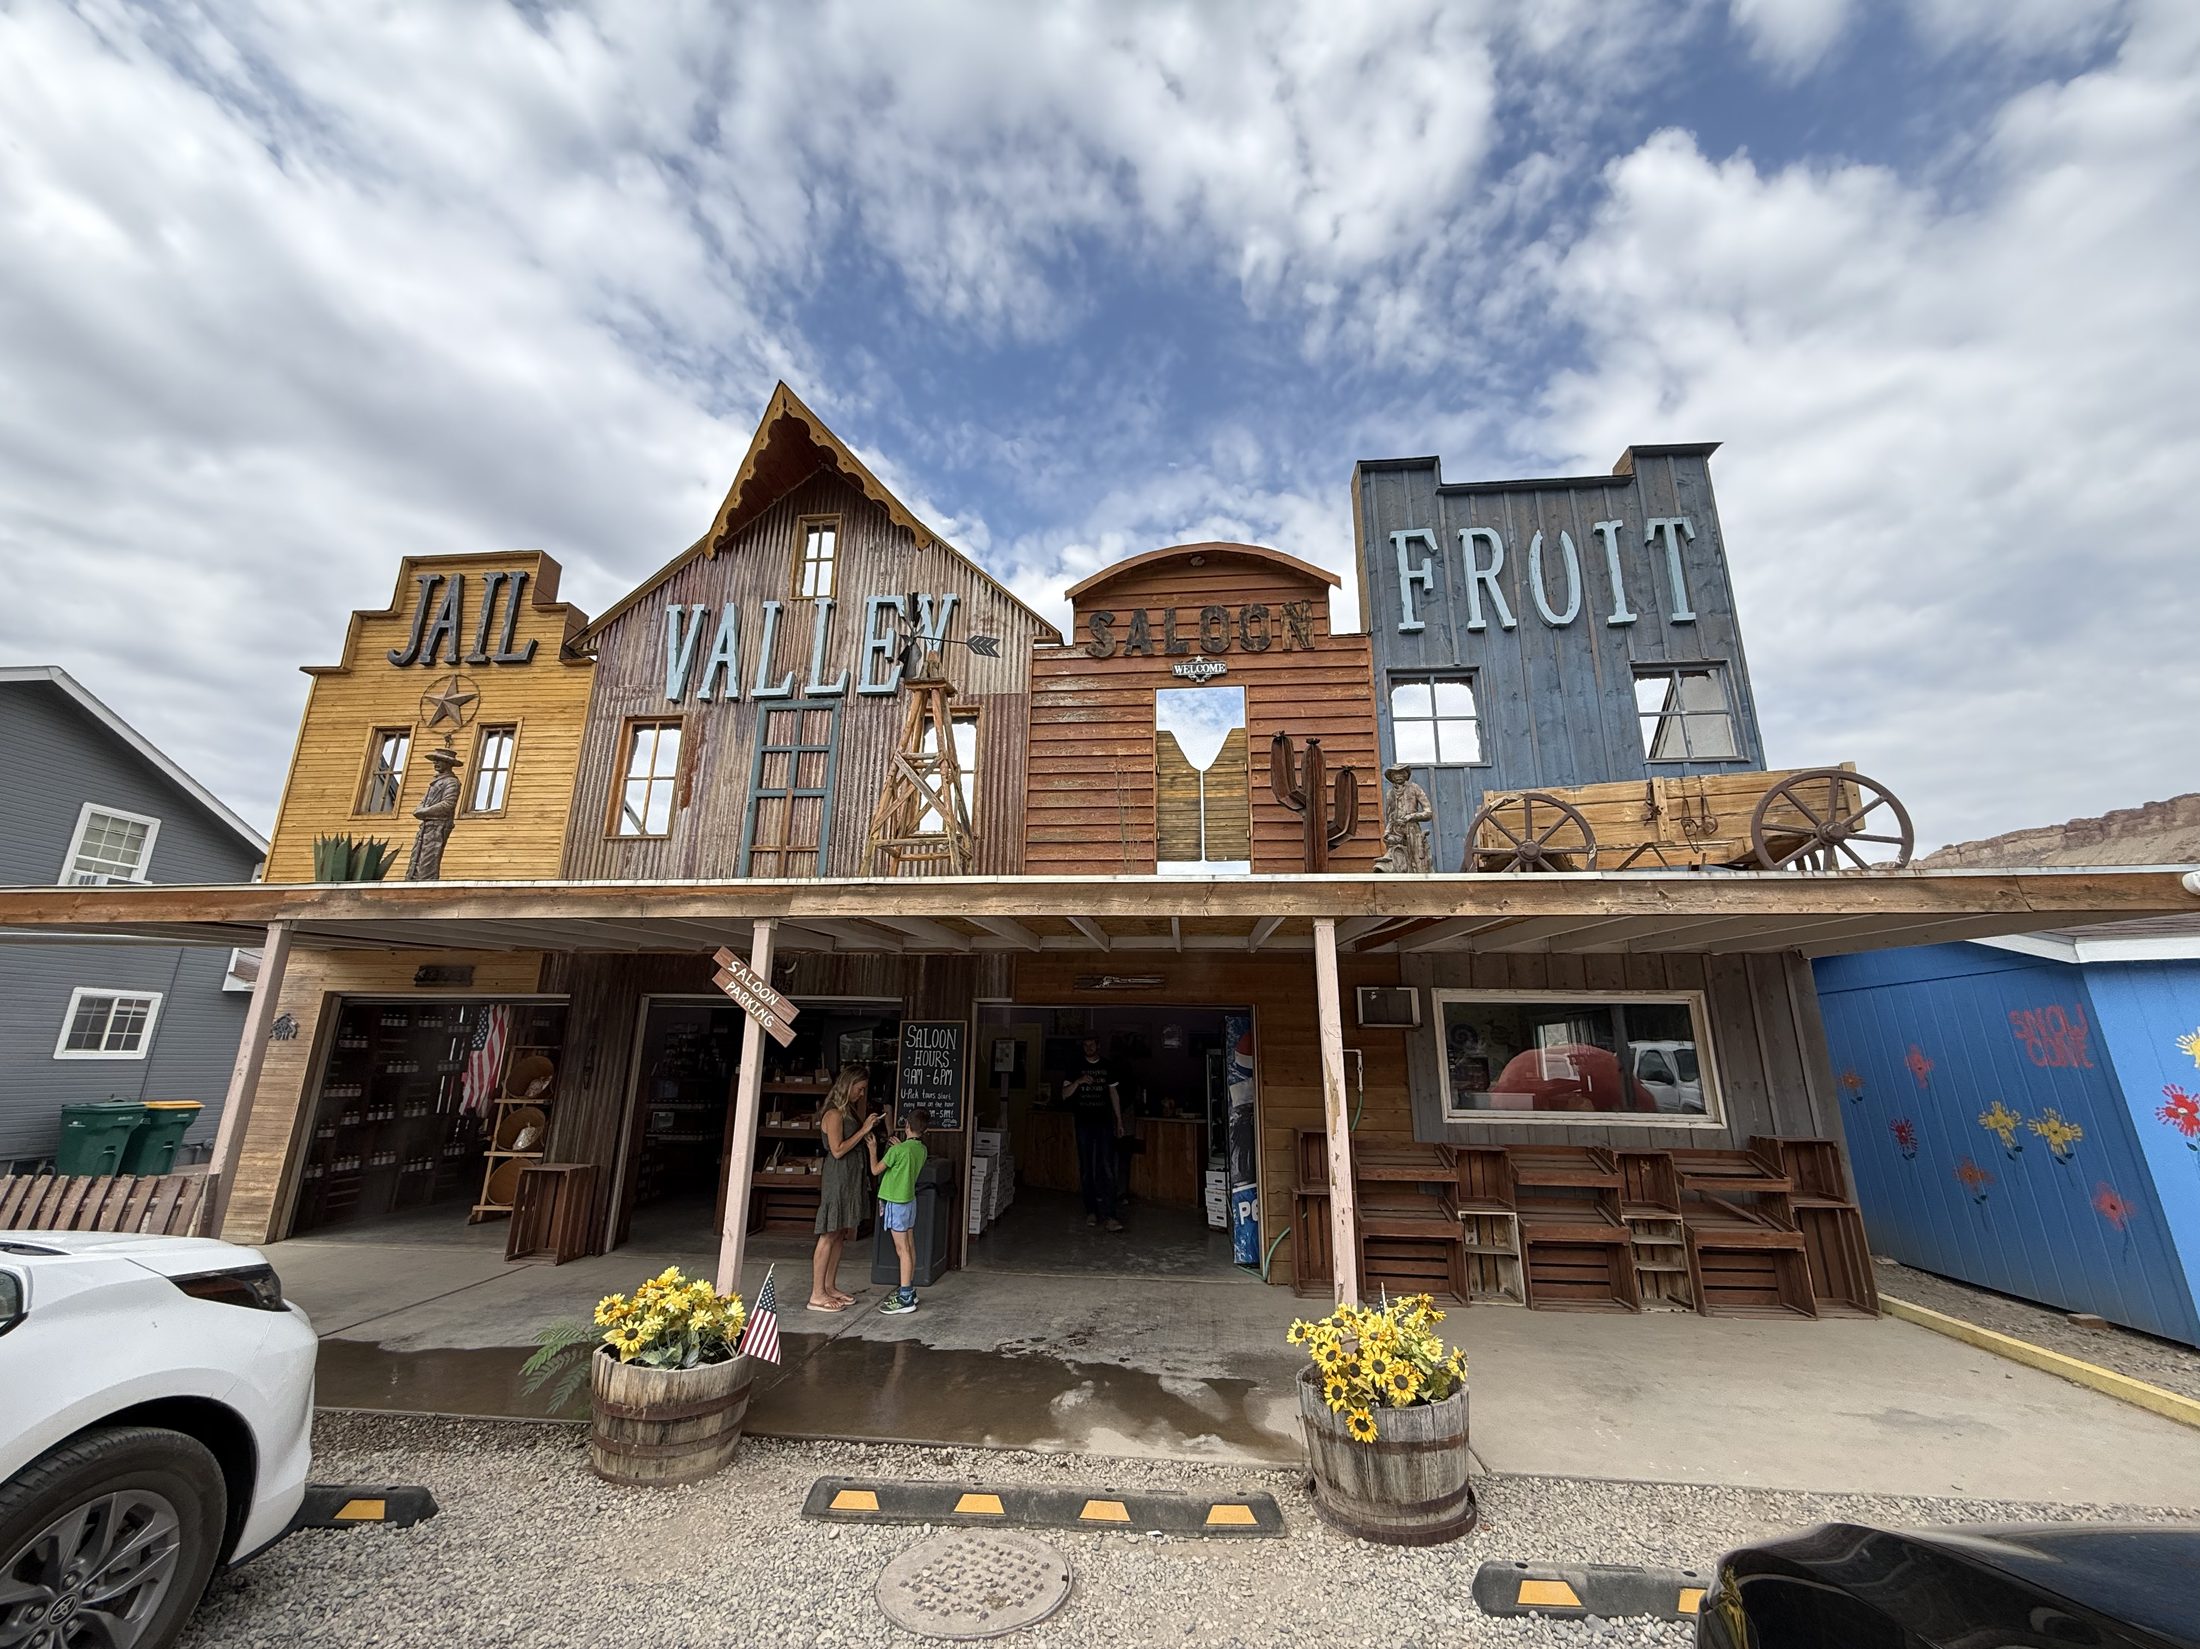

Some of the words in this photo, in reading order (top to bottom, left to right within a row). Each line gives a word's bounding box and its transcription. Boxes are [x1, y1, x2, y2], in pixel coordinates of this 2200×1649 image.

[1389, 516, 1697, 633] FRUIT
[386, 571, 539, 667] JAIL
[1086, 599, 1316, 659] SALOON
[665, 593, 960, 701] VALLEY
[1173, 663, 1227, 674] WELCOME
[725, 981, 775, 1027] PARKING
[727, 960, 780, 1006] SALOON
[905, 1024, 957, 1050] SALOON
[913, 1050, 950, 1068] HOURS
[903, 1067, 923, 1085] 9AM
[932, 1069, 953, 1086] 6PM
